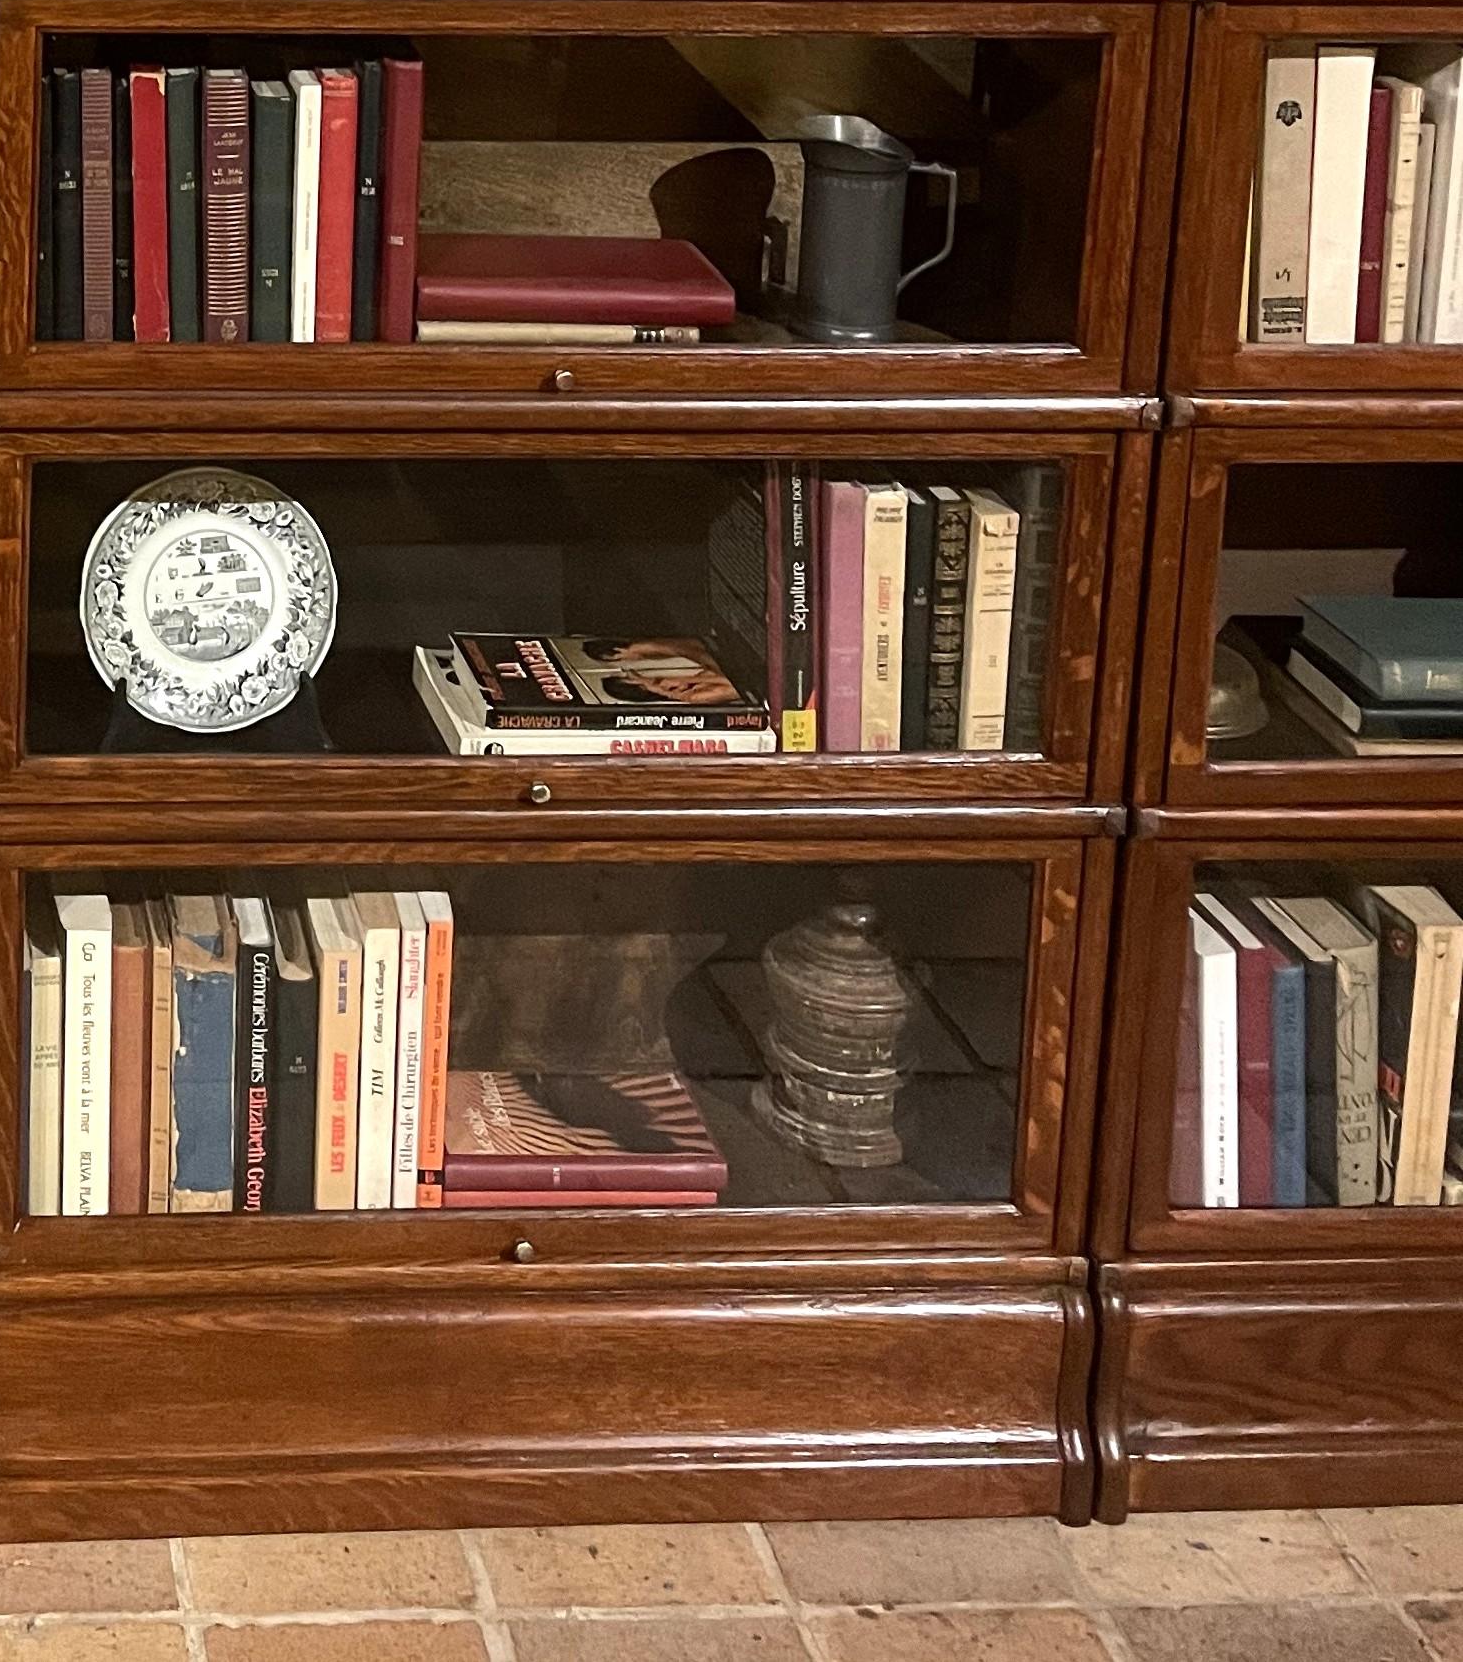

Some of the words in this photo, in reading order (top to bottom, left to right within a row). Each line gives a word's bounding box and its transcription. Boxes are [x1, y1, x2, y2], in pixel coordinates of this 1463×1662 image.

[789, 561, 809, 631] Sépulture
[496, 714, 561, 729] CRAVACHE
[564, 715, 580, 729] LA
[616, 715, 668, 729] Jeancard
[671, 716, 705, 729] Pierre
[83, 973, 95, 998] Tous
[252, 953, 269, 1025] Cérémonies
[82, 1003, 95, 1016] les
[82, 1020, 94, 1056] fleuves
[250, 1028, 267, 1083] barbares
[81, 1060, 93, 1084] vont
[371, 1068, 384, 1096] TIM
[401, 1031, 418, 1110] Chirurgien
[81, 1099, 93, 1108] la
[80, 1113, 91, 1134] mer
[247, 1086, 267, 1163] Elizabeth
[331, 1115, 347, 1147] FEUX
[400, 1113, 415, 1131] de
[331, 1152, 345, 1173] LES
[397, 1133, 414, 1173] Filles
[79, 1151, 91, 1182] BELVA
